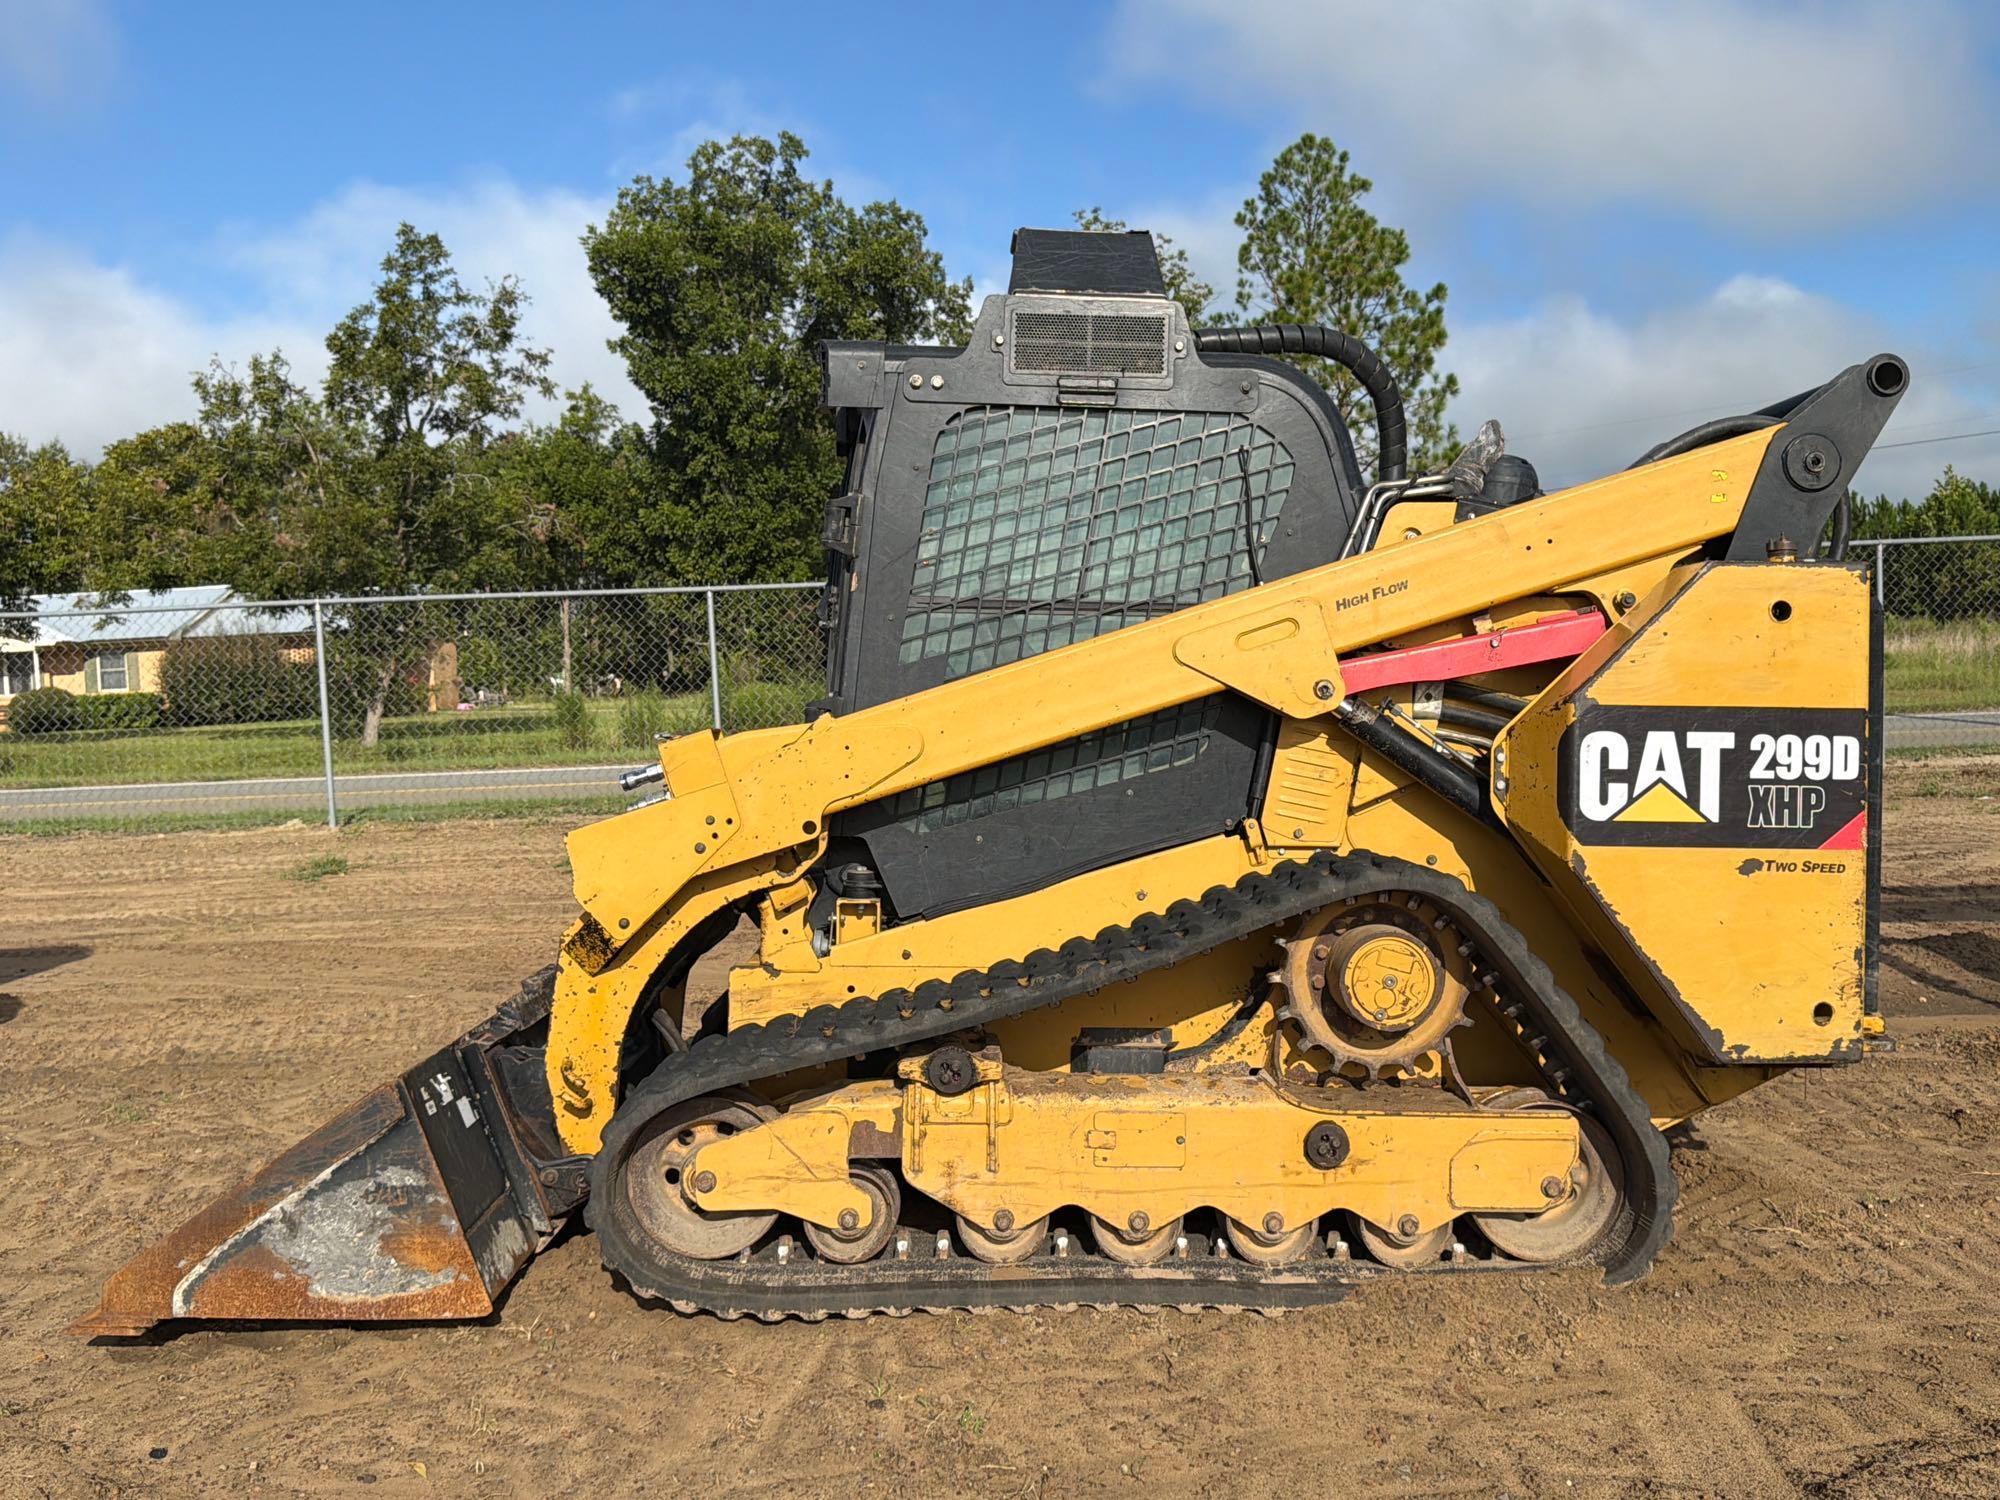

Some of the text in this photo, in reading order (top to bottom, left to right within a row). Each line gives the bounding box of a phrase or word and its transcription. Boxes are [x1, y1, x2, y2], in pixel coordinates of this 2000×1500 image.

[1336, 580, 1409, 611] HIGH FLOW
[1578, 730, 1735, 823] CAT
[1748, 734, 1860, 781] 299D
[1747, 785, 1825, 828] XHP
[1765, 859, 1846, 874] TWO SPEED
